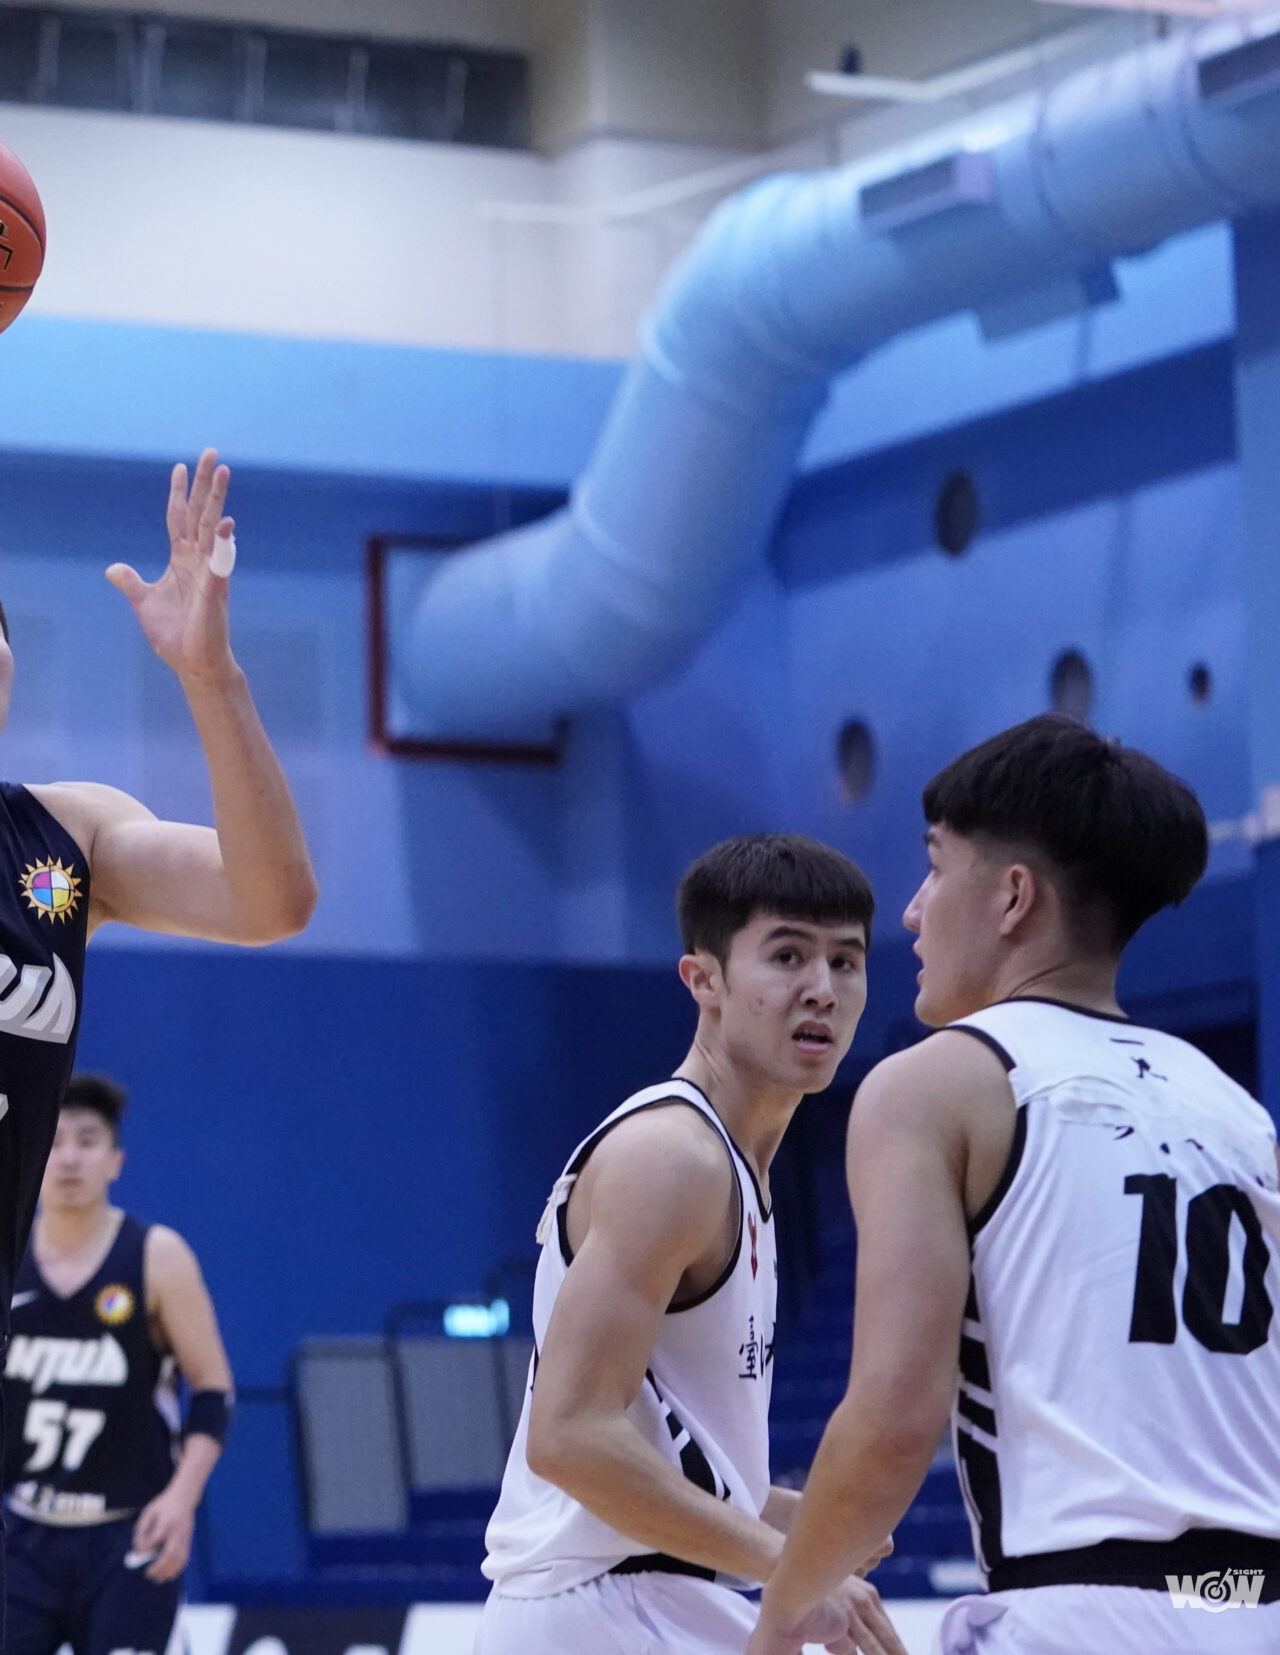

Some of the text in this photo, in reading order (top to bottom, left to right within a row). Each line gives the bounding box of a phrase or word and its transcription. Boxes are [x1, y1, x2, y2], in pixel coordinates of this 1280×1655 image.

[1123, 1172, 1275, 1355] 10
[4, 1332, 129, 1396] NTUA
[22, 1399, 107, 1473] 57
